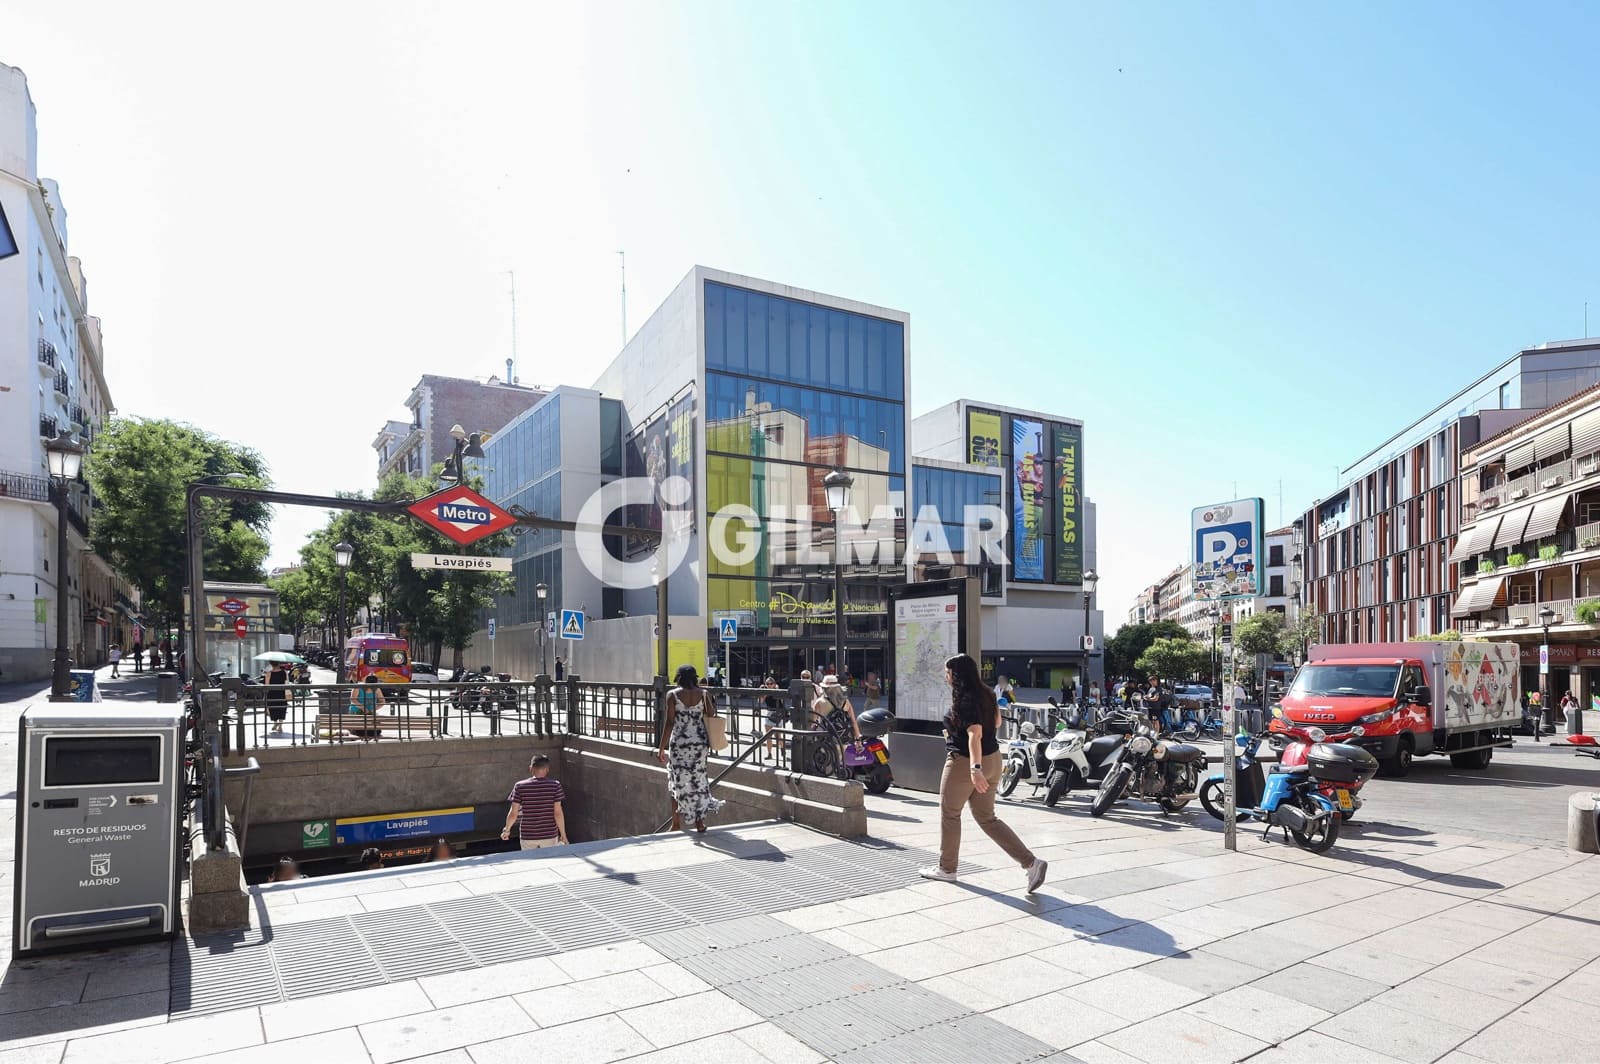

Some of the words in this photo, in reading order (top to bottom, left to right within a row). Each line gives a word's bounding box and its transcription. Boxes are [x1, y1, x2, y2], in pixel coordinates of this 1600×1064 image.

[1062, 446, 1077, 543] TINIEBLAS
[442, 505, 487, 521] Metro
[434, 556, 492, 568] Lavapiés
[739, 600, 766, 609] Centro
[786, 616, 805, 625] Teatro
[1303, 713, 1336, 721] IVECO
[53, 827, 85, 836] RESTO
[86, 826, 99, 834] DE
[100, 824, 147, 833] RESIDUOS
[386, 818, 429, 830] Lavapiés
[67, 835, 103, 844] General
[104, 833, 132, 841] Waste
[79, 876, 121, 888] MADRID
